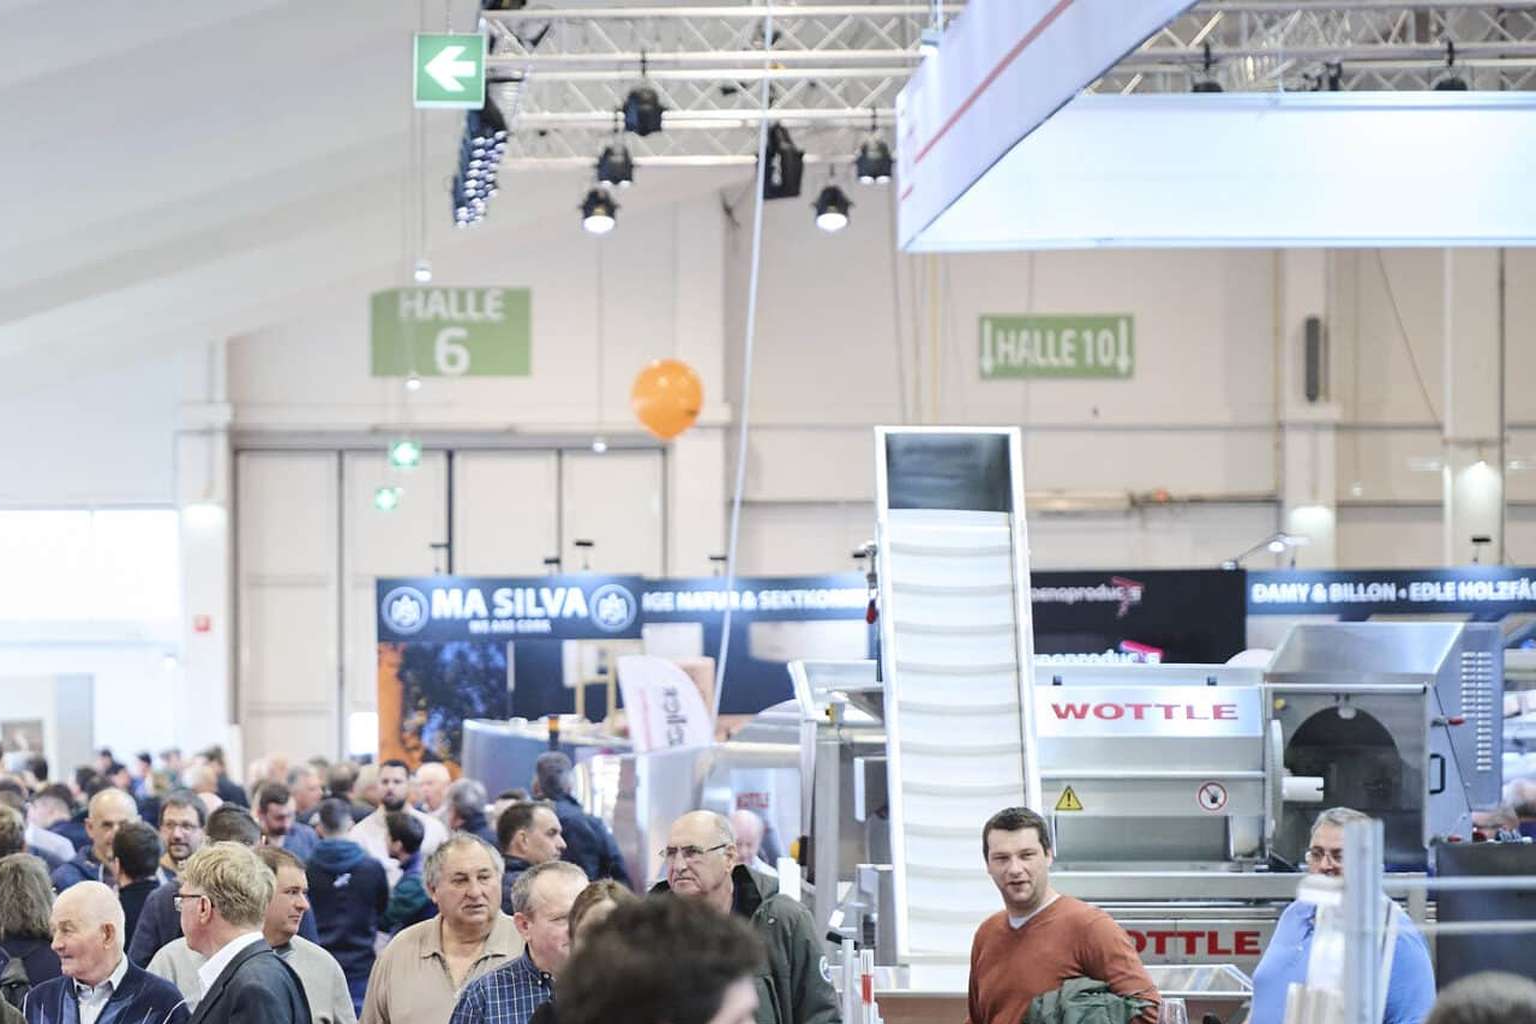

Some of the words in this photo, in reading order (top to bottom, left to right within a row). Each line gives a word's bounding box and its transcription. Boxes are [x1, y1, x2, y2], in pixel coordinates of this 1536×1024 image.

[399, 287, 506, 322] HALLE
[435, 326, 470, 376] 6
[995, 329, 1077, 367] HALLE
[1082, 329, 1115, 367] 10
[431, 588, 488, 619] MA
[493, 587, 589, 618] SILVA
[1252, 583, 1310, 603] DAMY
[1312, 583, 1327, 603] &
[1329, 582, 1396, 602] BILLON
[1409, 581, 1456, 601] EDLE
[1052, 703, 1239, 721] WOTTLE
